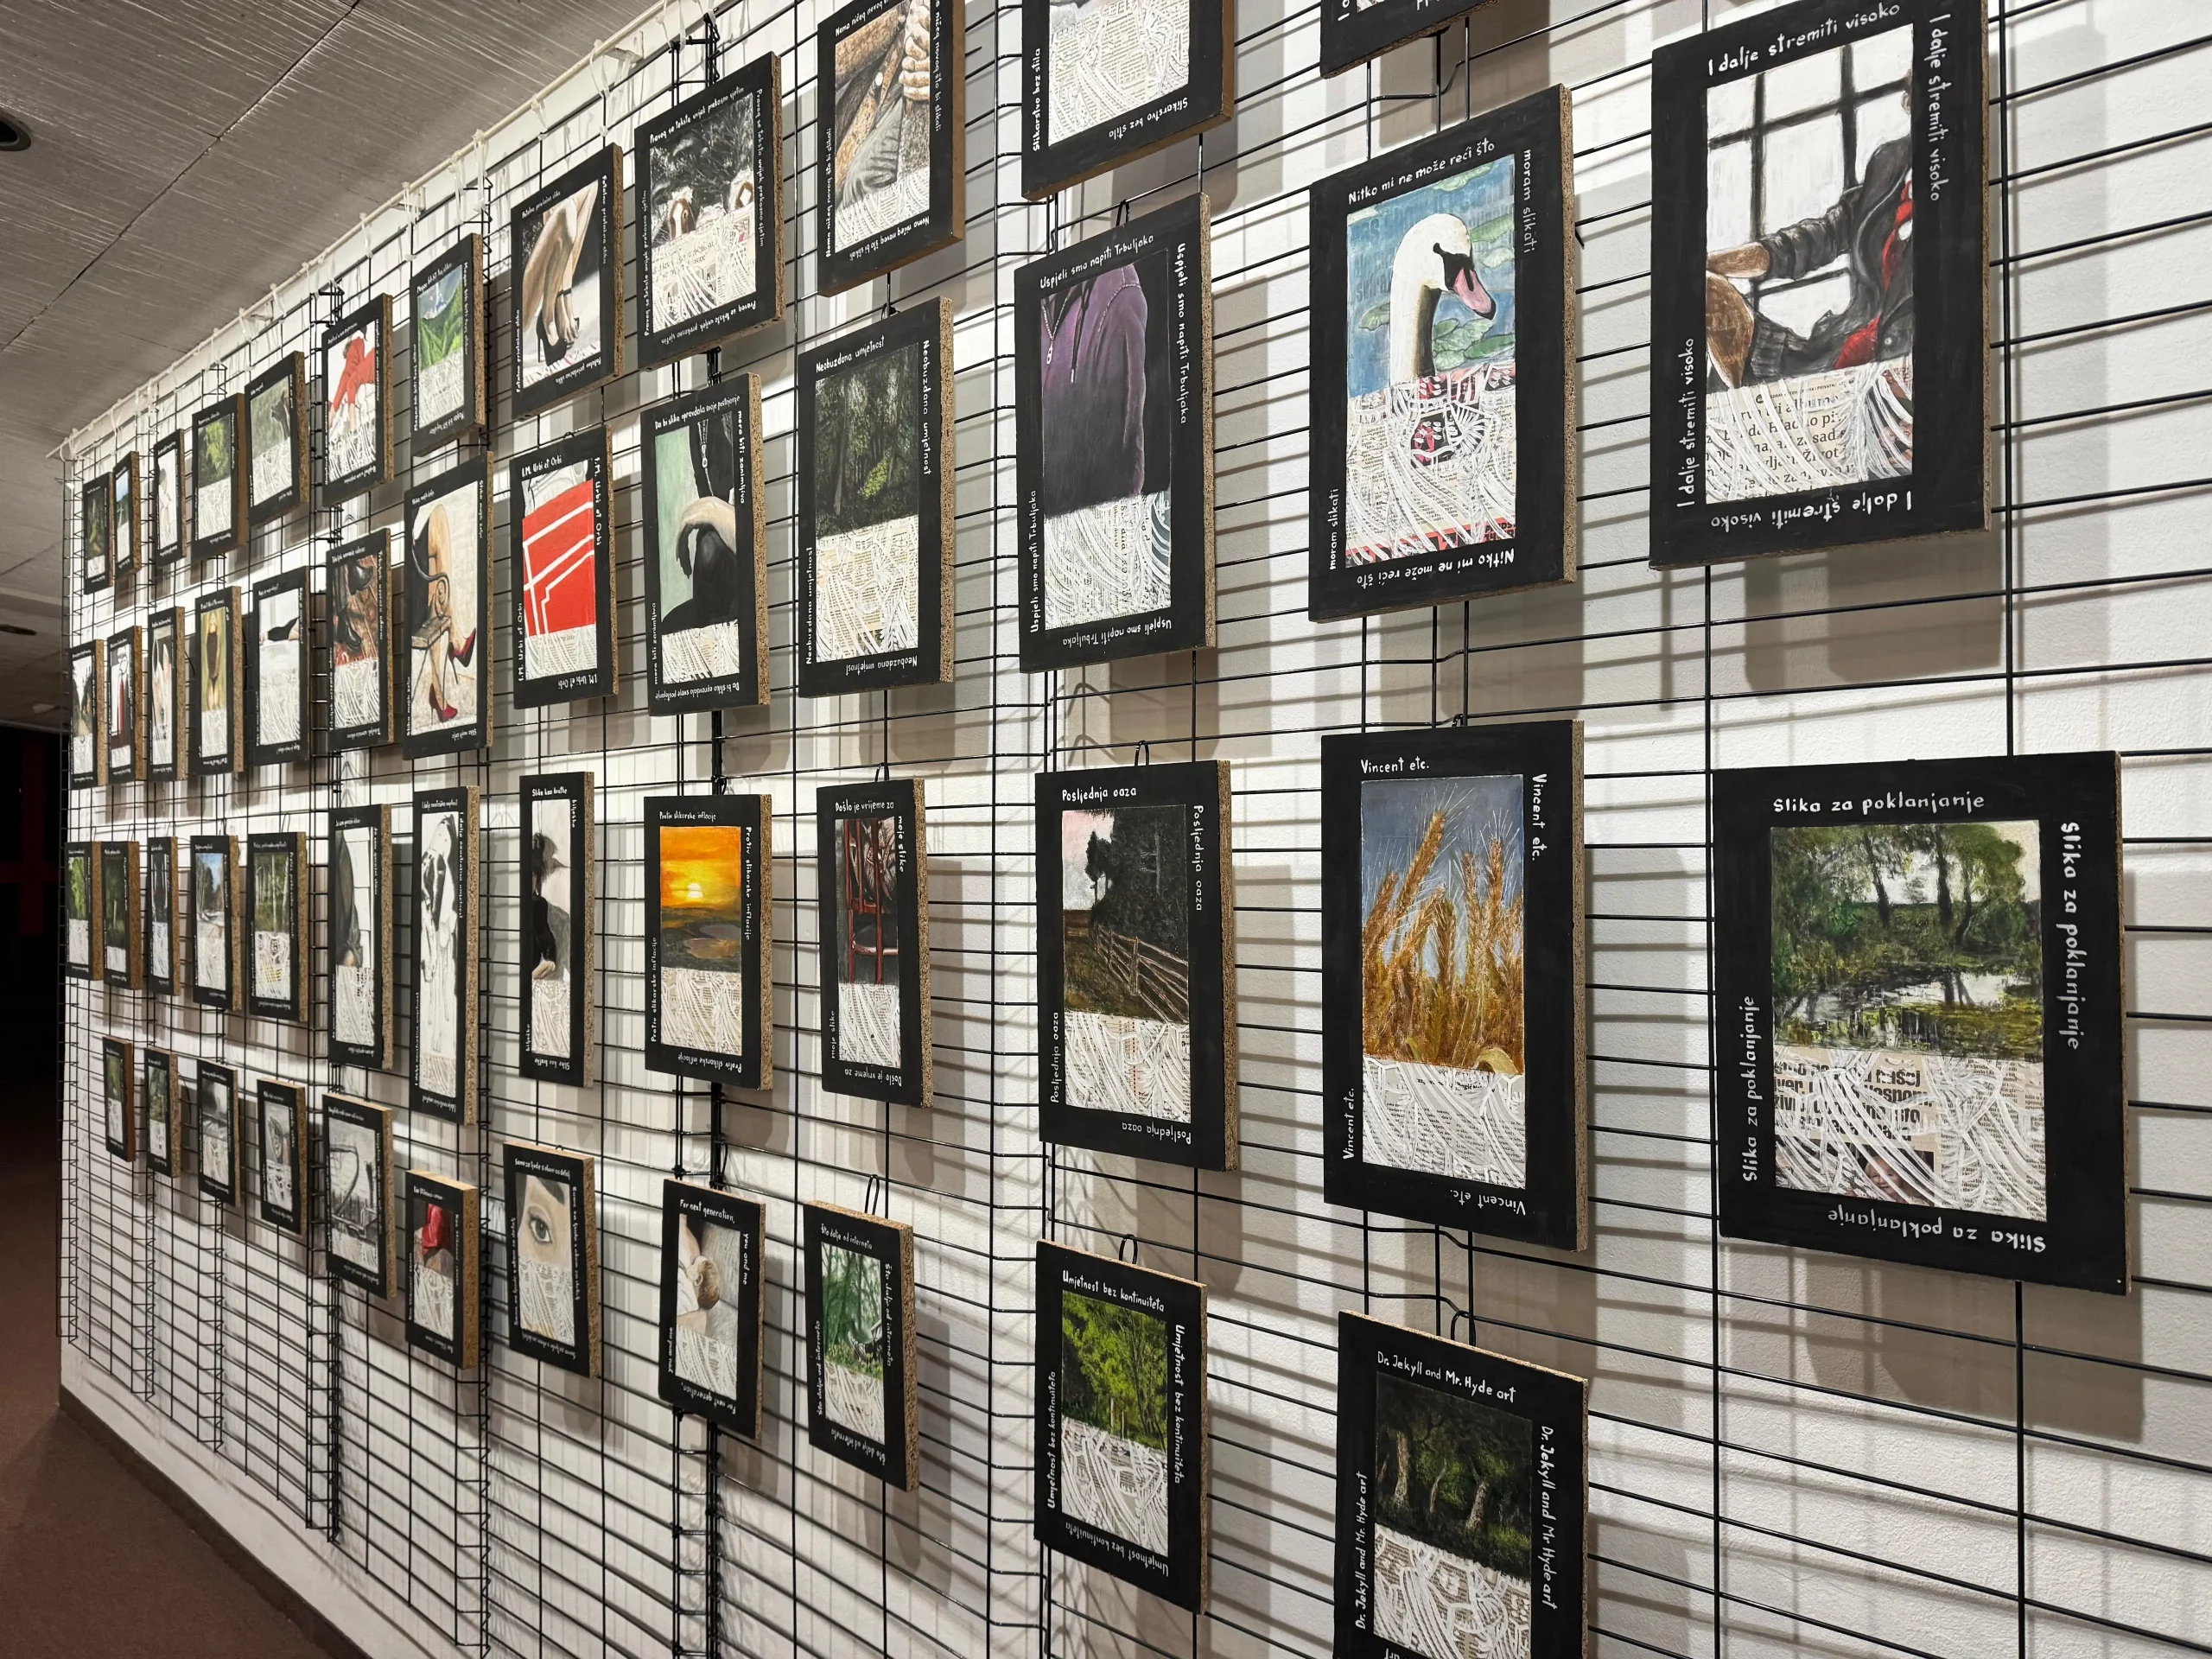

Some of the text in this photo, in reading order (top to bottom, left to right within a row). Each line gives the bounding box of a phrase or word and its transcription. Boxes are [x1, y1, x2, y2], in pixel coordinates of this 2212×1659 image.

[1707, 1, 1900, 76] I dalje stremiti visoko
[1030, 47, 1041, 151] Slikarstvo bez stila
[1108, 96, 1188, 140] Slikarstvo bez stila
[1923, 13, 1952, 201] I dalje stremiti visoko
[1348, 137, 1495, 206] Nitko mi ne može reći što
[1522, 149, 1537, 253] moram slikati
[1039, 234, 1154, 289] Uspjeli smo napiti Trbuljaka
[815, 334, 885, 373] Neobuzdana umjetnost
[1173, 242, 1190, 424] Uspjeli smo napiti Trbuljaka
[1676, 337, 1694, 385] visoko
[920, 339, 932, 475] Neobuzdana umjetnost
[1677, 390, 1697, 450] stremiti
[737, 455, 747, 504] zanimljiva
[1677, 455, 1700, 494] dalje
[1027, 489, 1039, 540] Trbuljaka
[1326, 487, 1339, 570] moram slikati
[1710, 489, 1911, 532] I dalje stremiti visoko
[804, 545, 815, 597] umjetnost
[1027, 541, 1040, 570] napiti
[1356, 546, 1514, 589] Nitko mi ne može reći što
[1029, 595, 1041, 633] Uspjeli
[844, 654, 918, 677] Neobuzdana umjetnost
[1359, 754, 1430, 774] Vincent etc.
[834, 798, 894, 814] Došlo je vrijeme za
[1061, 785, 1137, 804] Posljednja oaza
[1530, 772, 1548, 861] Vincent etc.
[1772, 790, 1985, 816] Slika za poklanjanje
[895, 815, 906, 873] moje slike
[1189, 804, 1205, 873] Posljednja
[743, 825, 753, 940] Protiv slikarske inflacije
[2055, 821, 2087, 1050] Slika za poklanjanje
[1049, 1045, 1063, 1103] Posljednja
[1738, 995, 1764, 1181] Slika za poklanjanje
[1341, 1087, 1355, 1160] Vincent etc.
[1827, 1203, 2046, 1253] Slika za poklanjanje
[741, 1271, 747, 1286] me
[882, 1281, 893, 1307] dalje
[884, 1262, 893, 1281] Što
[1062, 1268, 1165, 1313] Umjetnost bez kontinuiteta
[885, 1307, 893, 1320] od
[1377, 1350, 1516, 1403] Dr. Jekyll and Mr. Hyde art
[1171, 1323, 1185, 1484] Umjetnost bez kontinuiteta
[1046, 1370, 1058, 1509] Umjetnost bez kontinuiteta
[1536, 1425, 1558, 1610] Dr. Jekyll and Mr Hyde art
[1354, 1470, 1370, 1630] Dr. Jekyll and Mr. Hyde art
